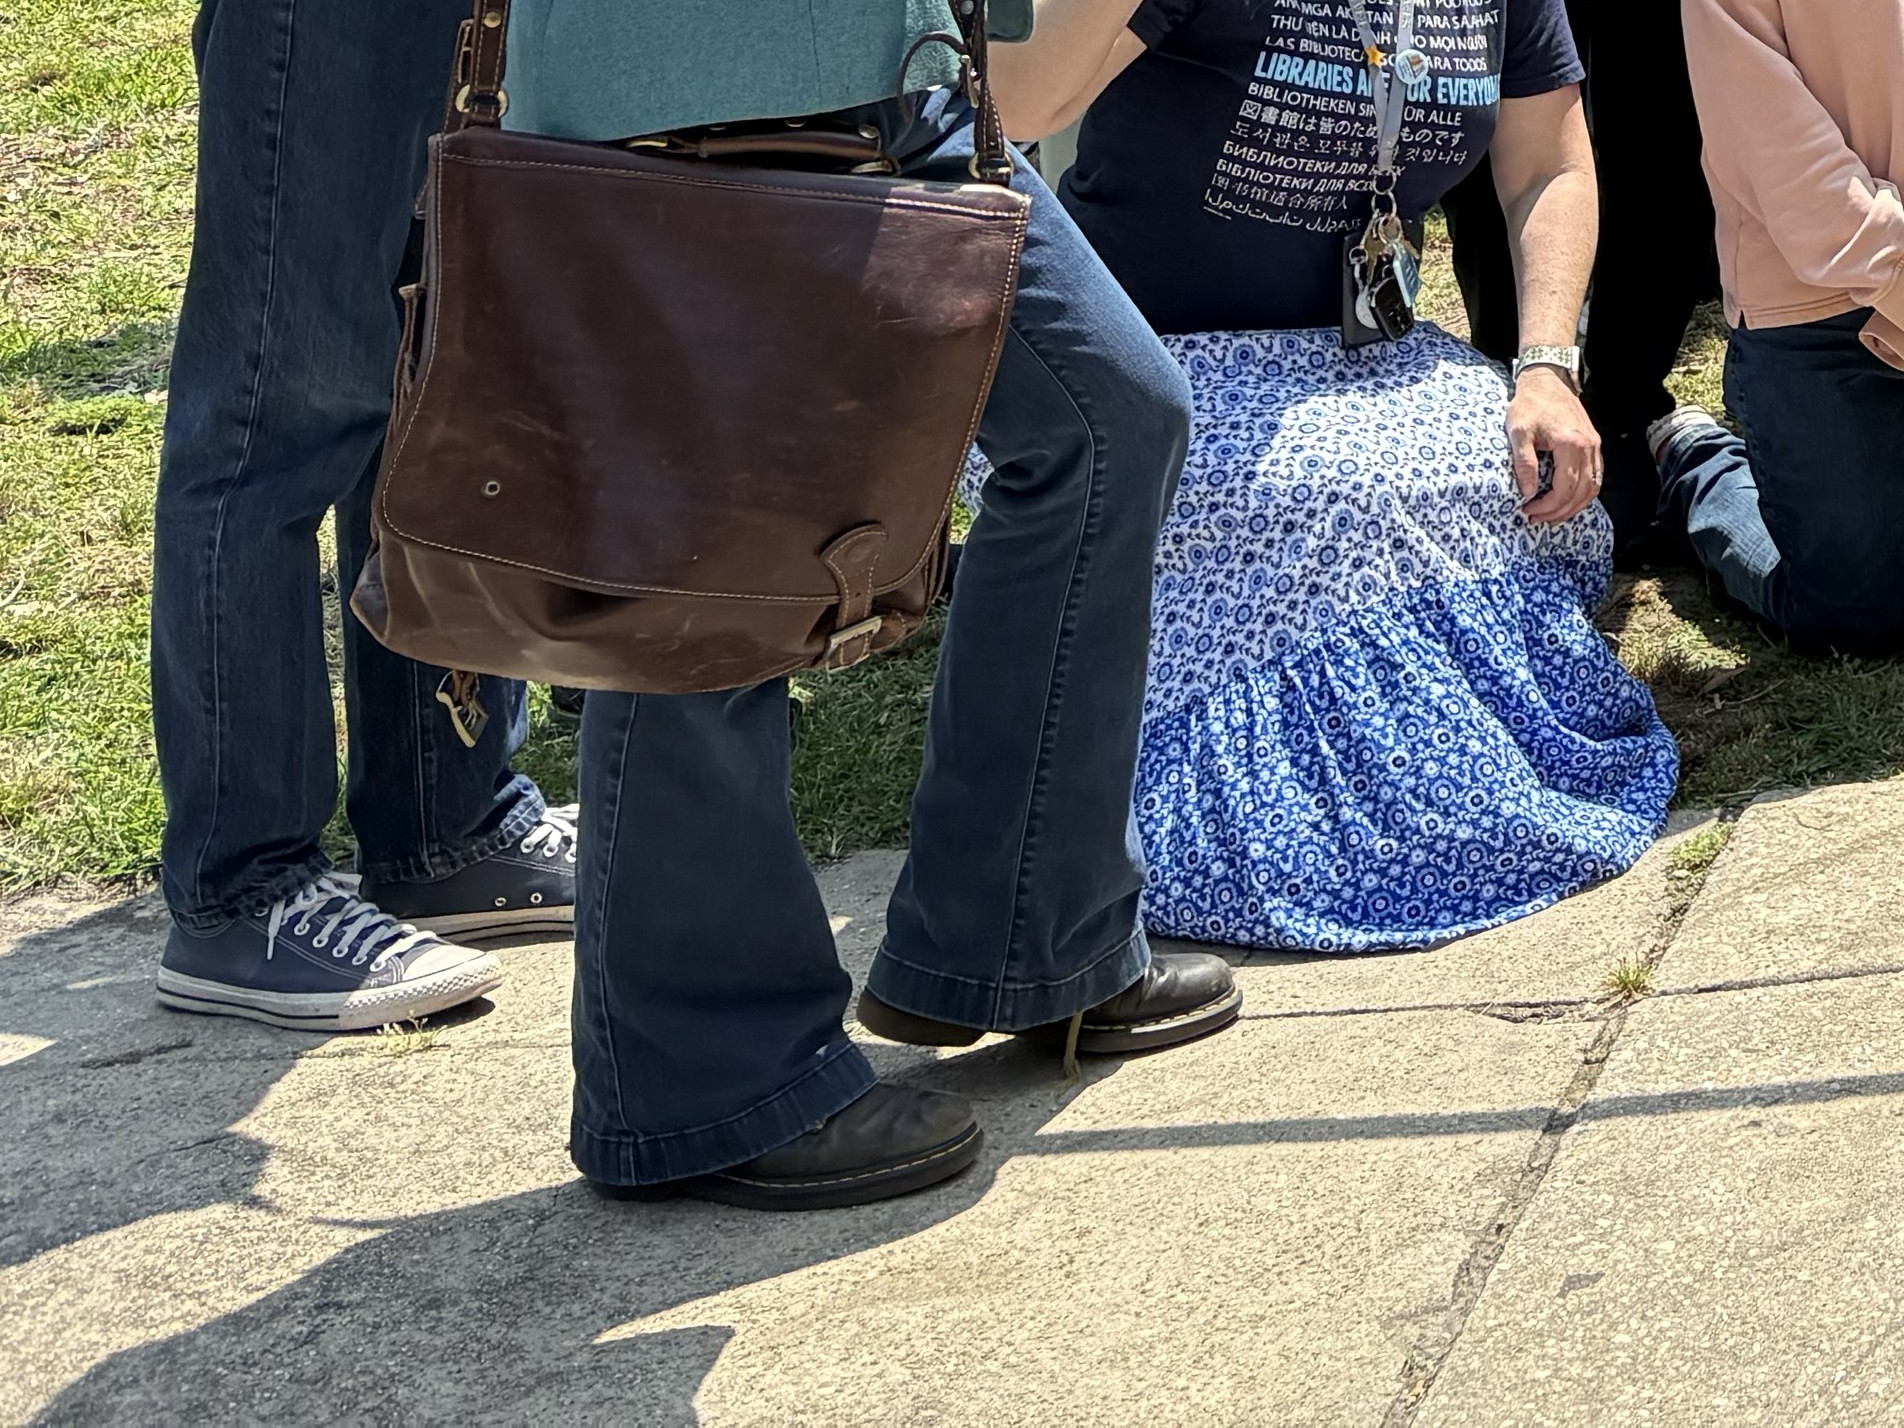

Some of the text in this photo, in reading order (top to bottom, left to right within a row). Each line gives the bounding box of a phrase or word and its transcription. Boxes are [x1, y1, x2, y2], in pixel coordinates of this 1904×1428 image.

[1336, 5, 1393, 24] AKTAN
[1418, 15, 1450, 29] PARA
[1265, 36, 1295, 50] LAS
[1299, 38, 1365, 62] BIBLIOTEC
[1453, 57, 1488, 72] TODOS
[1254, 51, 1354, 94] LIBRARIES
[1356, 69, 1391, 97] AE
[1406, 75, 1432, 102] OR
[1248, 82, 1356, 116] BIBLIOTHEKEN
[1427, 110, 1462, 126] ALLE
[1216, 158, 1314, 190] БІБЛІОТЕКИ
[1223, 140, 1336, 175] БИБЛИОТЕКИ
